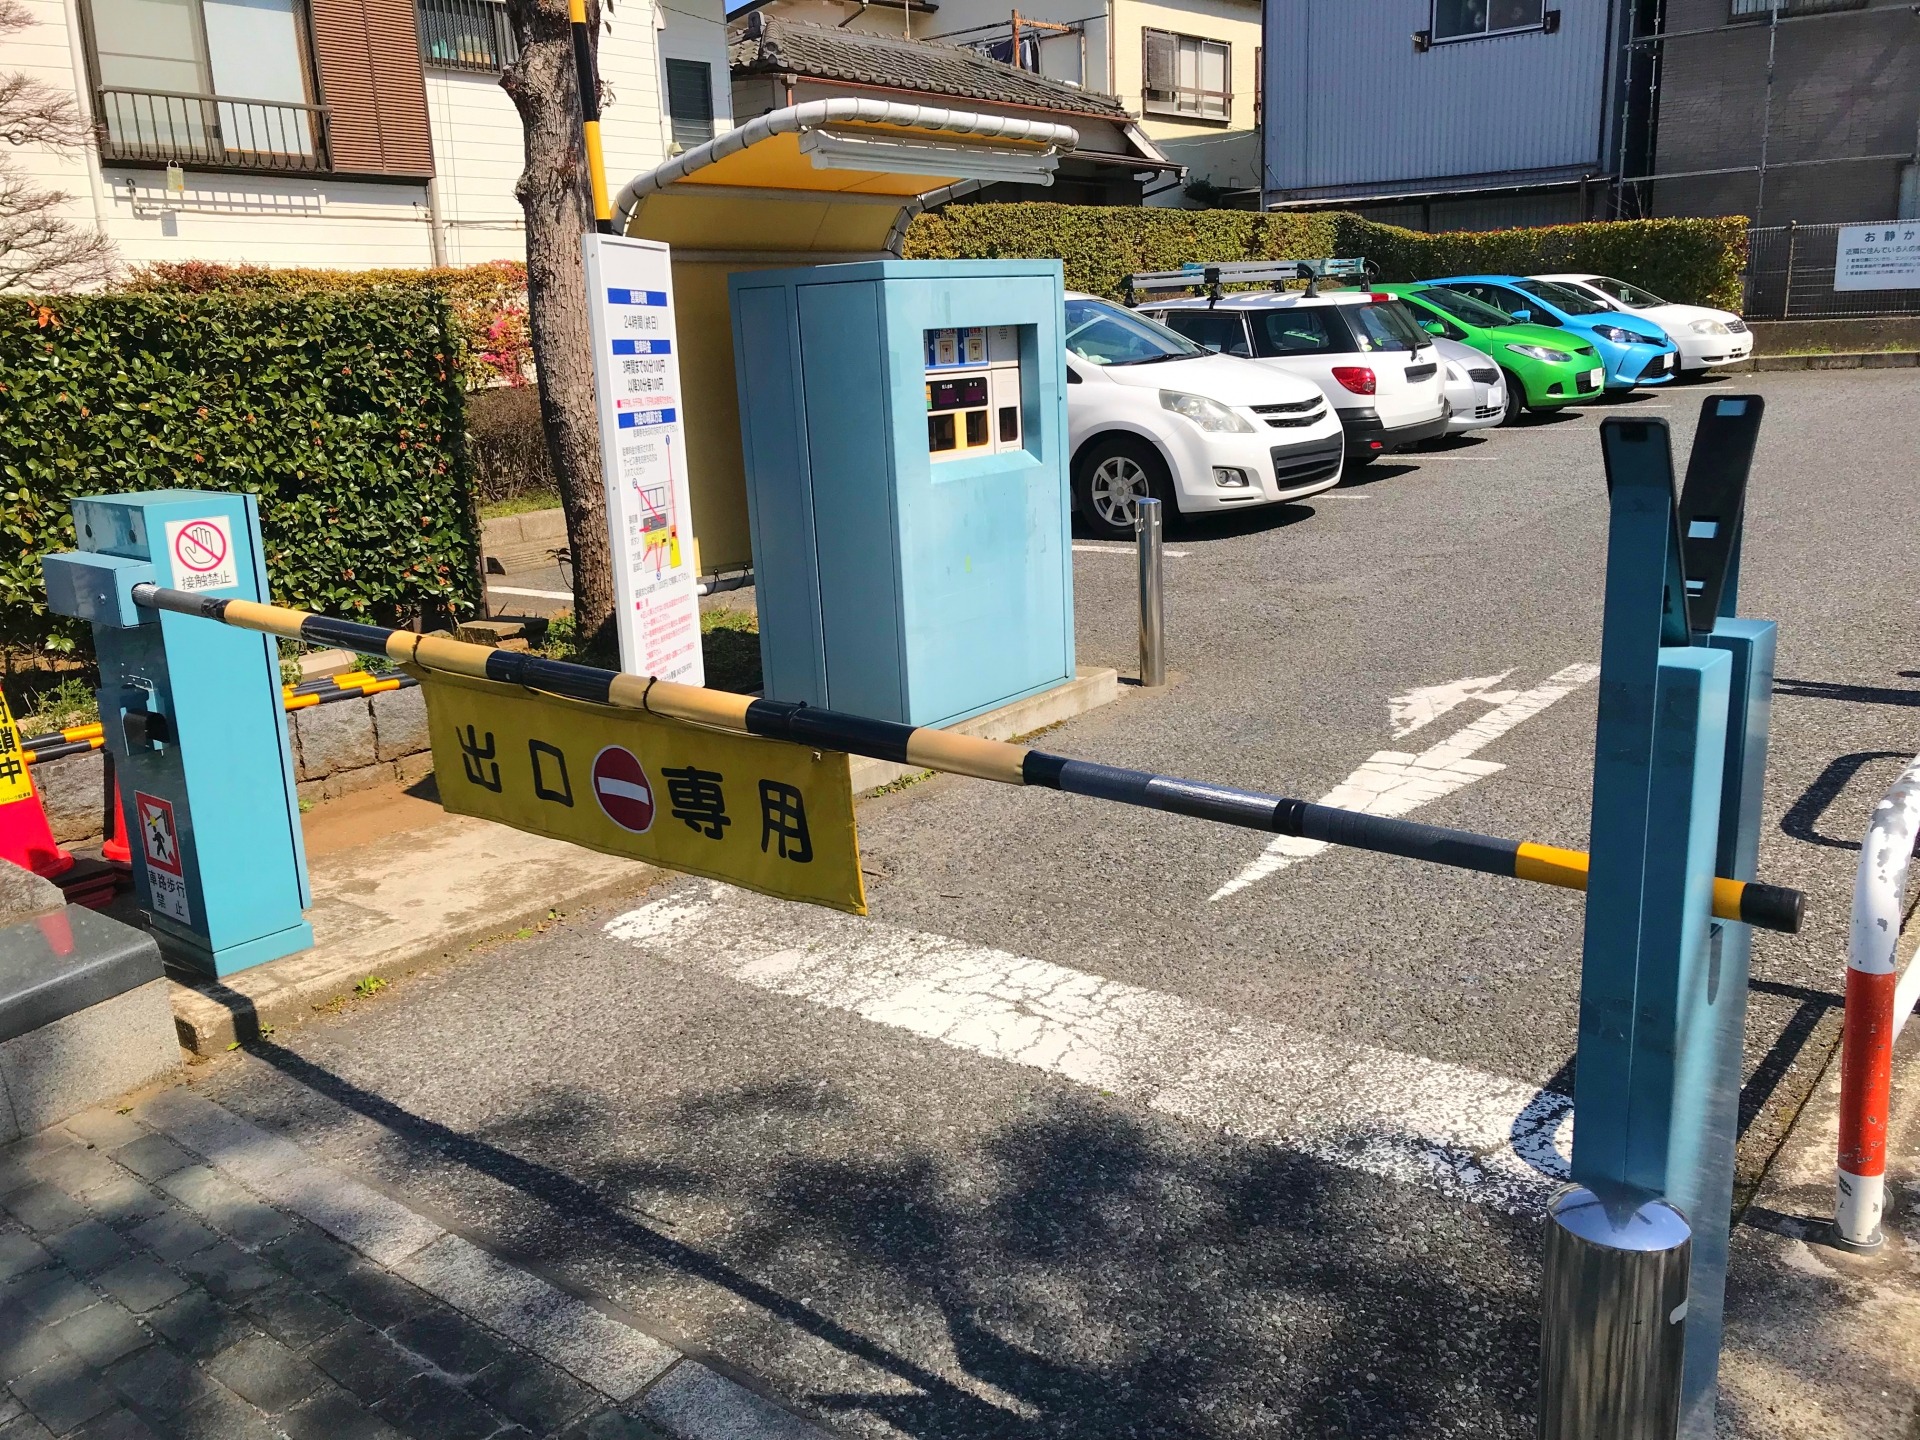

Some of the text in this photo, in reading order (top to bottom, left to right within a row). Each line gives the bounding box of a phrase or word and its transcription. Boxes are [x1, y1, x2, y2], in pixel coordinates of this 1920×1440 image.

[181, 570, 232, 590] 接触禁止
[456, 724, 814, 864] 出口 専用
[148, 870, 186, 898] 車路歩行
[156, 892, 185, 917] 禁止
